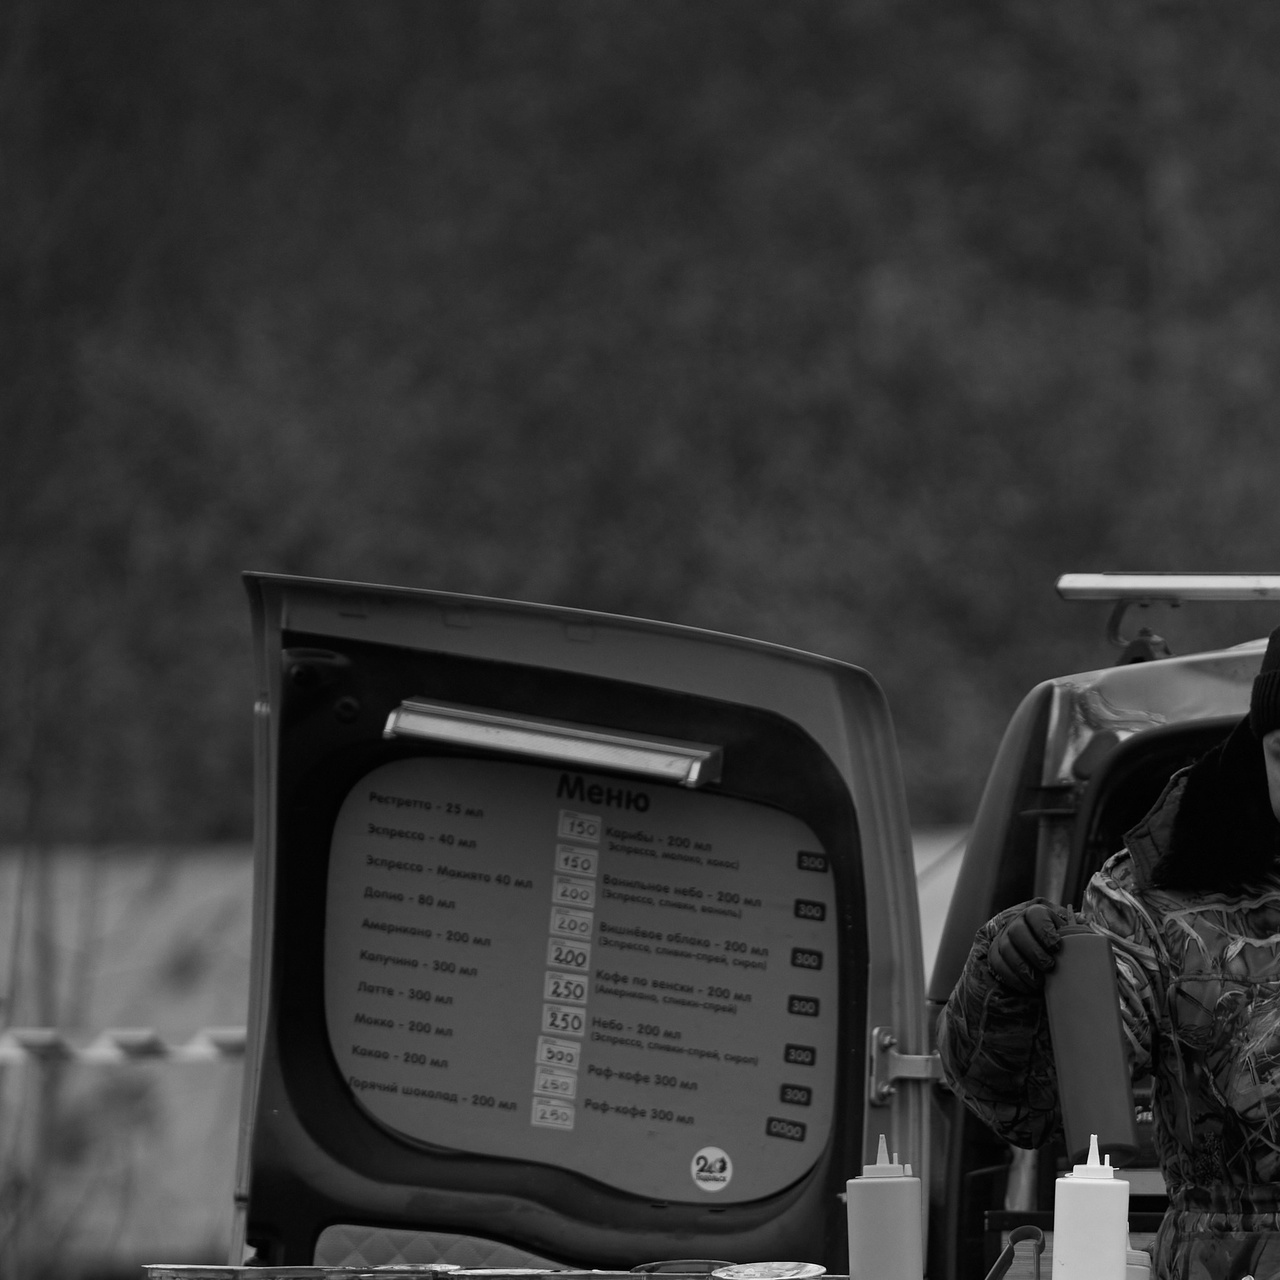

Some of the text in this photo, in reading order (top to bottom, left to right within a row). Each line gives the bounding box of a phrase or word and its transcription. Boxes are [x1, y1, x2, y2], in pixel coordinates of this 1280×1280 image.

[557, 774, 650, 812] Меню
[369, 791, 431, 811] Рестретто
[446, 803, 461, 814] 25
[465, 807, 483, 818] мл
[368, 823, 424, 841] Эспрессо
[439, 834, 454, 845] 40
[458, 837, 476, 849] мл
[570, 820, 597, 836] 150
[606, 827, 653, 843] Карибы
[668, 836, 690, 849] 200
[694, 841, 712, 852] мл
[366, 855, 423, 872] Эспрессо
[495, 874, 511, 885] 40
[515, 878, 532, 889] мл
[563, 856, 591, 870] 150
[801, 856, 825, 869] 300
[364, 887, 404, 902] Допио
[418, 894, 433, 906] 80
[438, 897, 455, 909] мл
[561, 888, 589, 901] 200
[603, 874, 669, 893] Ванильное
[674, 886, 703, 899] небо
[717, 891, 739, 904] 200
[744, 897, 762, 907] мл
[798, 904, 822, 918] 300
[362, 918, 431, 937] Американо
[446, 930, 469, 943] 200
[473, 935, 491, 946] мл
[558, 918, 589, 933] 200
[600, 922, 663, 940] Вишнёвое
[667, 932, 710, 947] облако
[725, 940, 747, 954] 200
[751, 947, 769, 957] мл
[360, 949, 418, 967] Капучино
[433, 960, 456, 973] 300
[459, 966, 477, 976] мл
[554, 947, 586, 966] 200
[795, 952, 818, 966] 300
[358, 981, 394, 996] Латте
[408, 988, 431, 1002] 300
[435, 994, 453, 1005] мл
[552, 981, 584, 999] 250
[596, 969, 628, 985] Кофе
[632, 976, 648, 986] по
[652, 979, 693, 993] венски
[708, 986, 730, 999] 200
[734, 992, 752, 1003] мл
[792, 1000, 815, 1013] 300
[408, 1021, 431, 1033] 200
[435, 1026, 453, 1036] мл
[549, 1012, 581, 1030] 250
[592, 1017, 623, 1031] Небо
[637, 1024, 660, 1037] 200
[663, 1030, 682, 1040] мл
[352, 1045, 389, 1060] Какао
[404, 1052, 426, 1065] 200
[430, 1058, 448, 1068] мл
[788, 1049, 812, 1062] 300
[542, 1078, 569, 1091] 250
[588, 1064, 698, 1090] Раф-кофе 300 мл
[349, 1076, 398, 1093] Горячий
[402, 1086, 458, 1103] шоколад
[472, 1095, 494, 1107] 200
[499, 1100, 517, 1111] мл
[784, 1088, 808, 1102] 300
[540, 1109, 568, 1122] 250
[585, 1098, 695, 1125] Раф-кофе 300 мл
